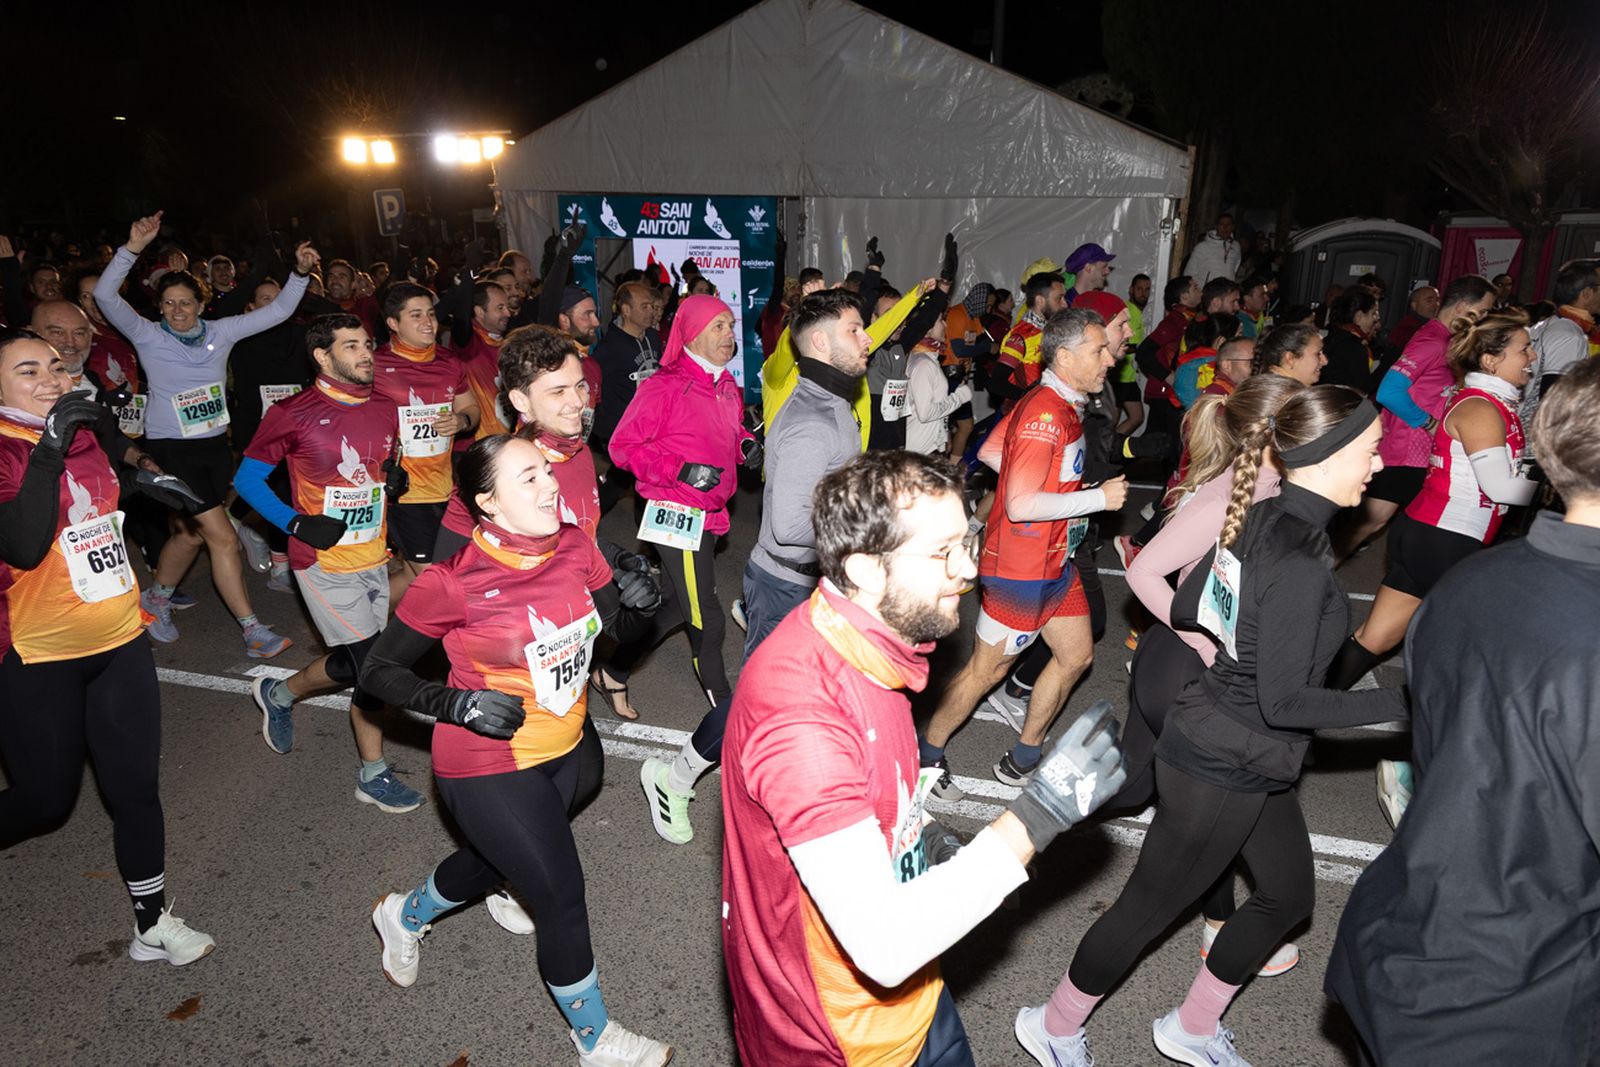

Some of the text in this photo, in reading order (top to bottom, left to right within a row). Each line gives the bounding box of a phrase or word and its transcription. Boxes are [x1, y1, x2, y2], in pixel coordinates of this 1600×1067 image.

[382, 195, 400, 220] P
[640, 201, 692, 219] 43 SAN
[608, 219, 618, 231] 43
[636, 216, 690, 236] ANTÓN
[712, 221, 722, 232] 43
[182, 398, 223, 421] 12988
[351, 468, 367, 485] 43
[333, 500, 348, 508] SAN
[340, 505, 374, 526] 7725
[655, 508, 694, 532] 8681
[80, 523, 111, 541] NOCHE DE
[74, 540, 91, 554] SAN
[548, 630, 582, 654] NOCHE DE
[541, 653, 558, 669] SAN
